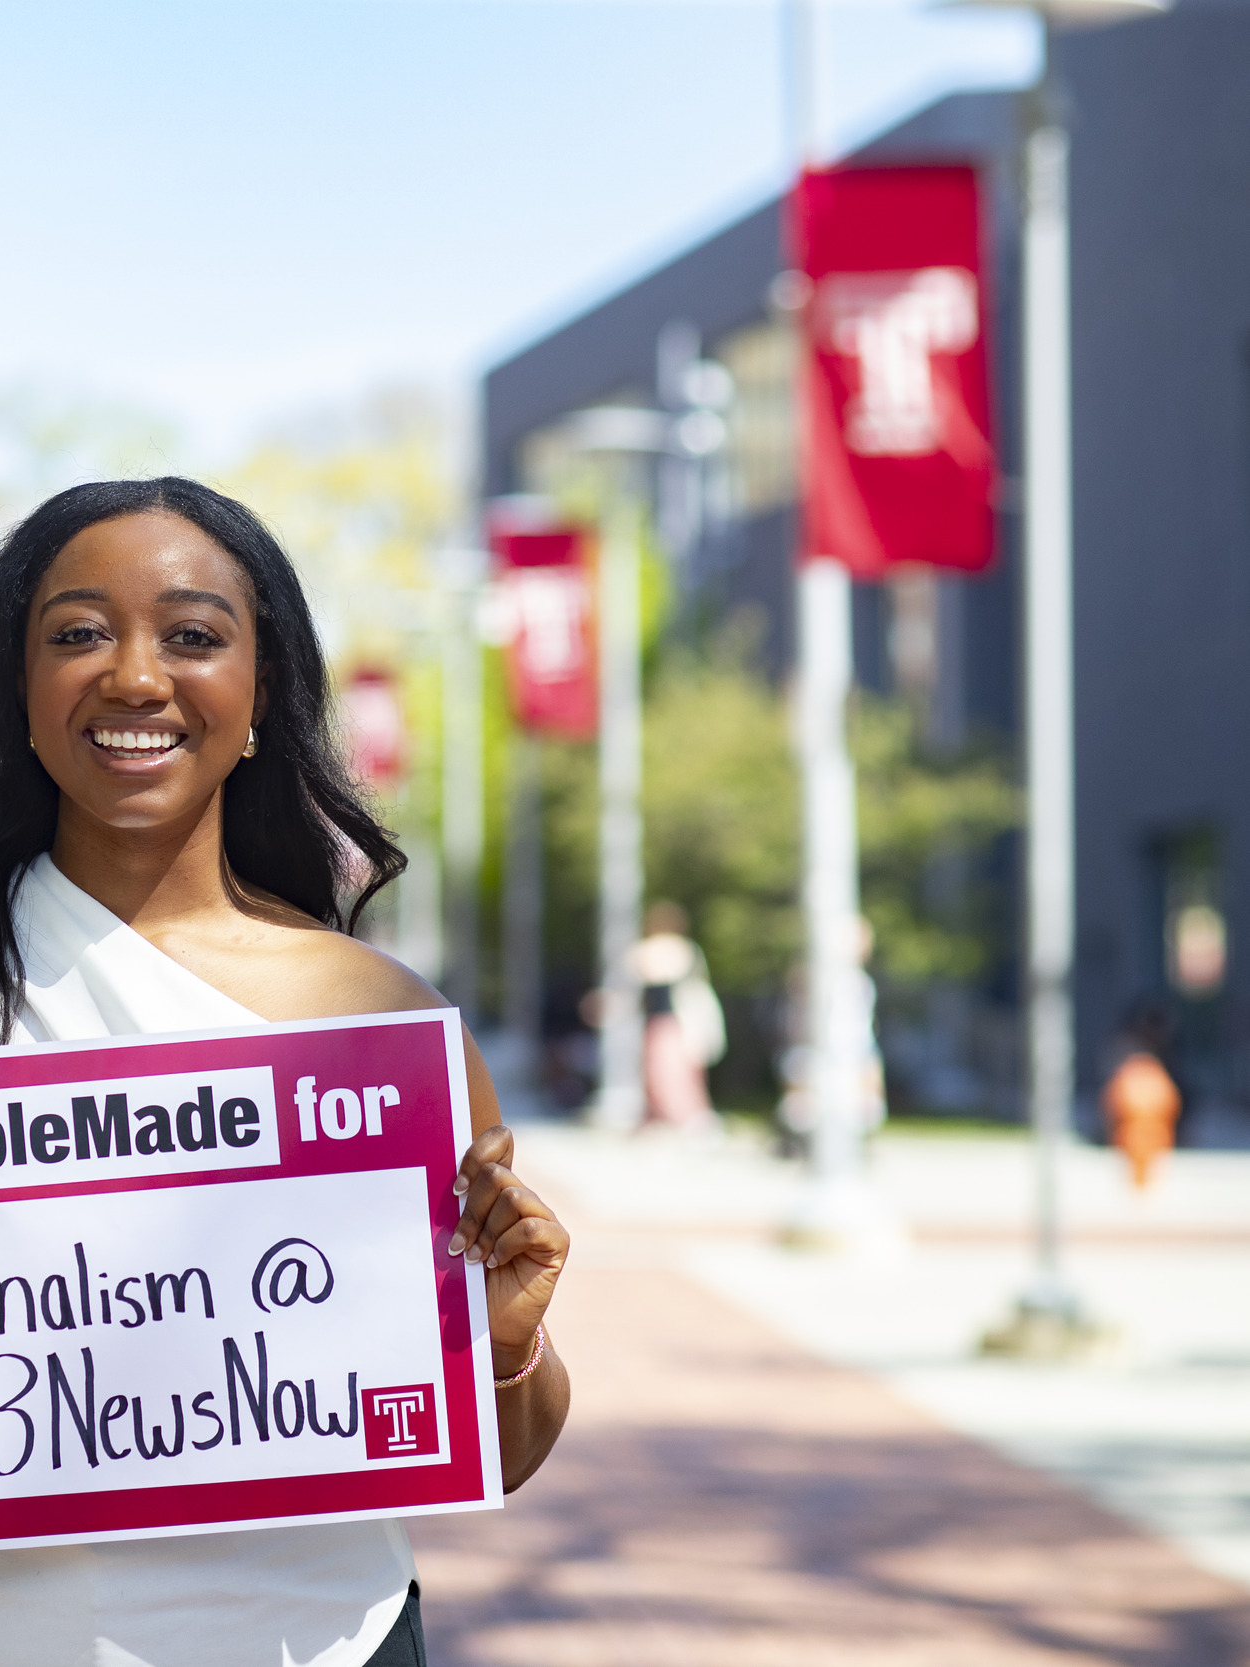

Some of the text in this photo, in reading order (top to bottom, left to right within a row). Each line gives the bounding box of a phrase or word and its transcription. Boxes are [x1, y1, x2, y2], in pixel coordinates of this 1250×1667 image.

[293, 1076, 400, 1142] for
[252, 1238, 334, 1313] @
[372, 1391, 425, 1451] T
